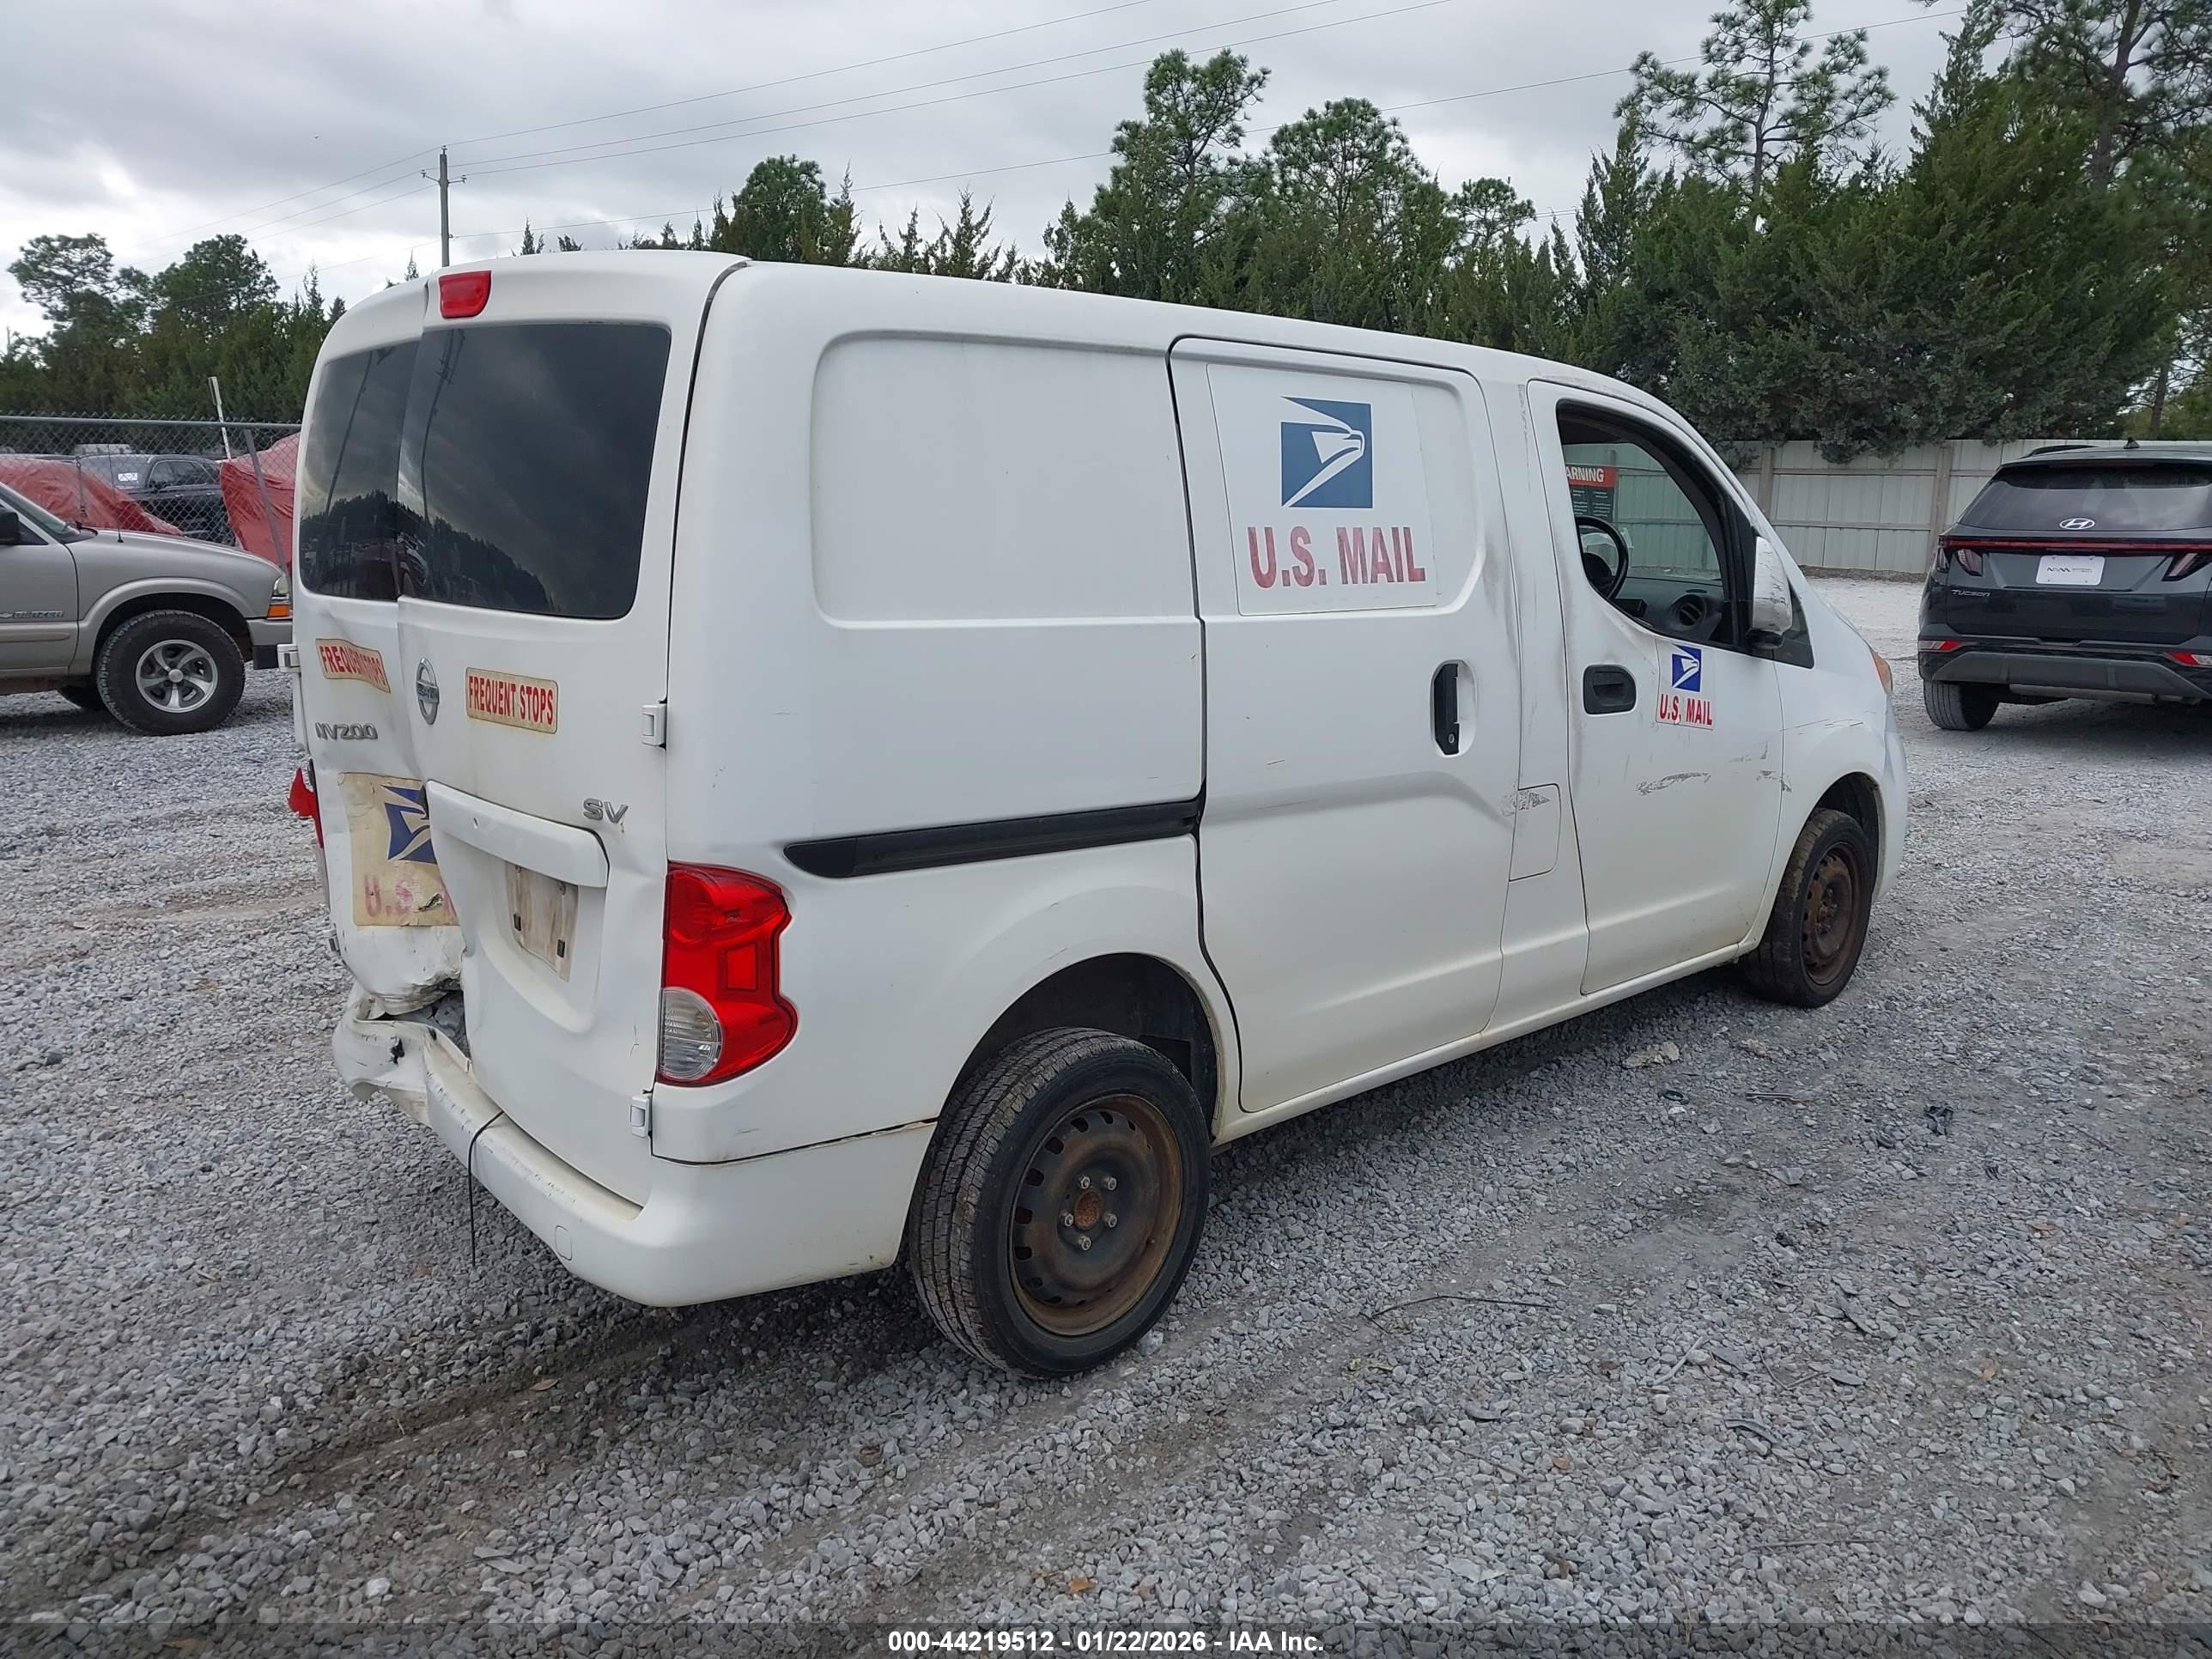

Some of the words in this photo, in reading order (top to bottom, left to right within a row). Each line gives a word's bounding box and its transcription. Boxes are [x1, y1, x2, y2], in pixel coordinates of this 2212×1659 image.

[1565, 466, 1605, 483] ARNING
[1247, 526, 1328, 589] U.S.
[1336, 526, 1426, 585] MAIL
[469, 675, 516, 717] FREQUENT
[520, 684, 554, 726] STOPS
[1659, 694, 1681, 721] U.S.
[1686, 697, 1713, 726] MAIL
[314, 721, 378, 740] NV200
[583, 798, 629, 823] SV
